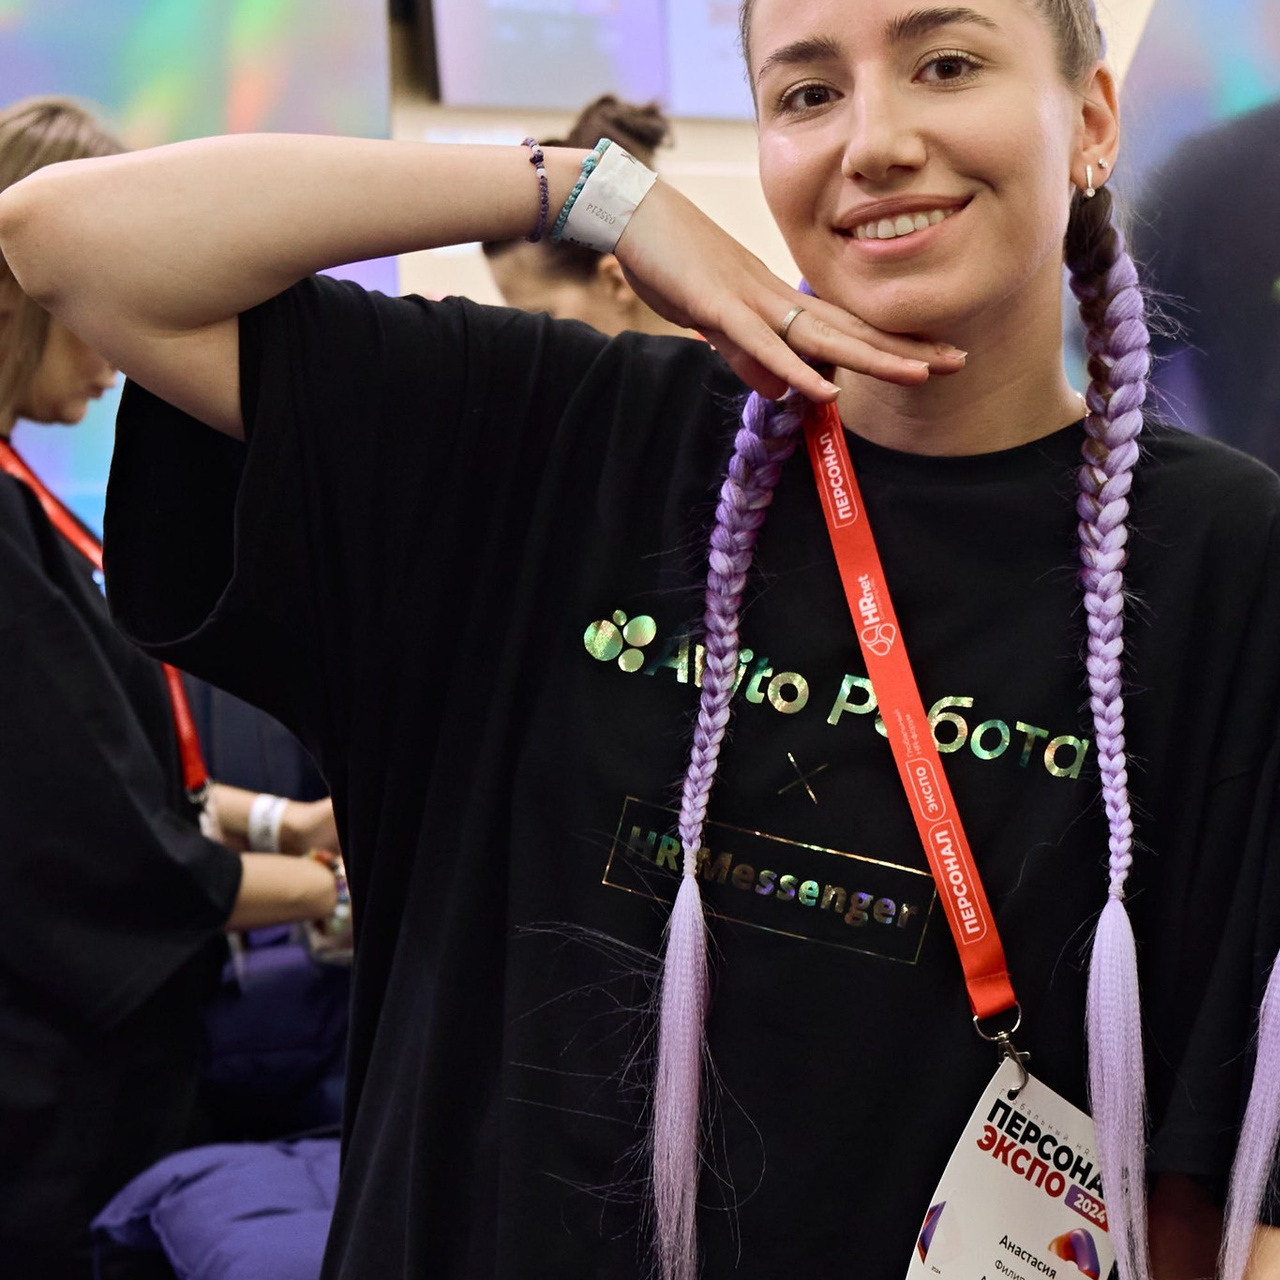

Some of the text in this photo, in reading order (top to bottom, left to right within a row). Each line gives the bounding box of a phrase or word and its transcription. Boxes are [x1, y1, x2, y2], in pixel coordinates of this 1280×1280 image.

[819, 432, 852, 520] ПЕРСОНАЛ
[857, 574, 881, 626] HRnet
[827, 673, 1089, 780] Рбота
[916, 766, 938, 813] ЭКСПО
[696, 845, 918, 928] Messenger
[935, 830, 980, 934] ПЕРСОНАЛ
[976, 1125, 1108, 1223] ЭКСПО 2024
[986, 1098, 1107, 1201] ПЕРСОНА
[999, 1234, 1057, 1280] Анастасия
